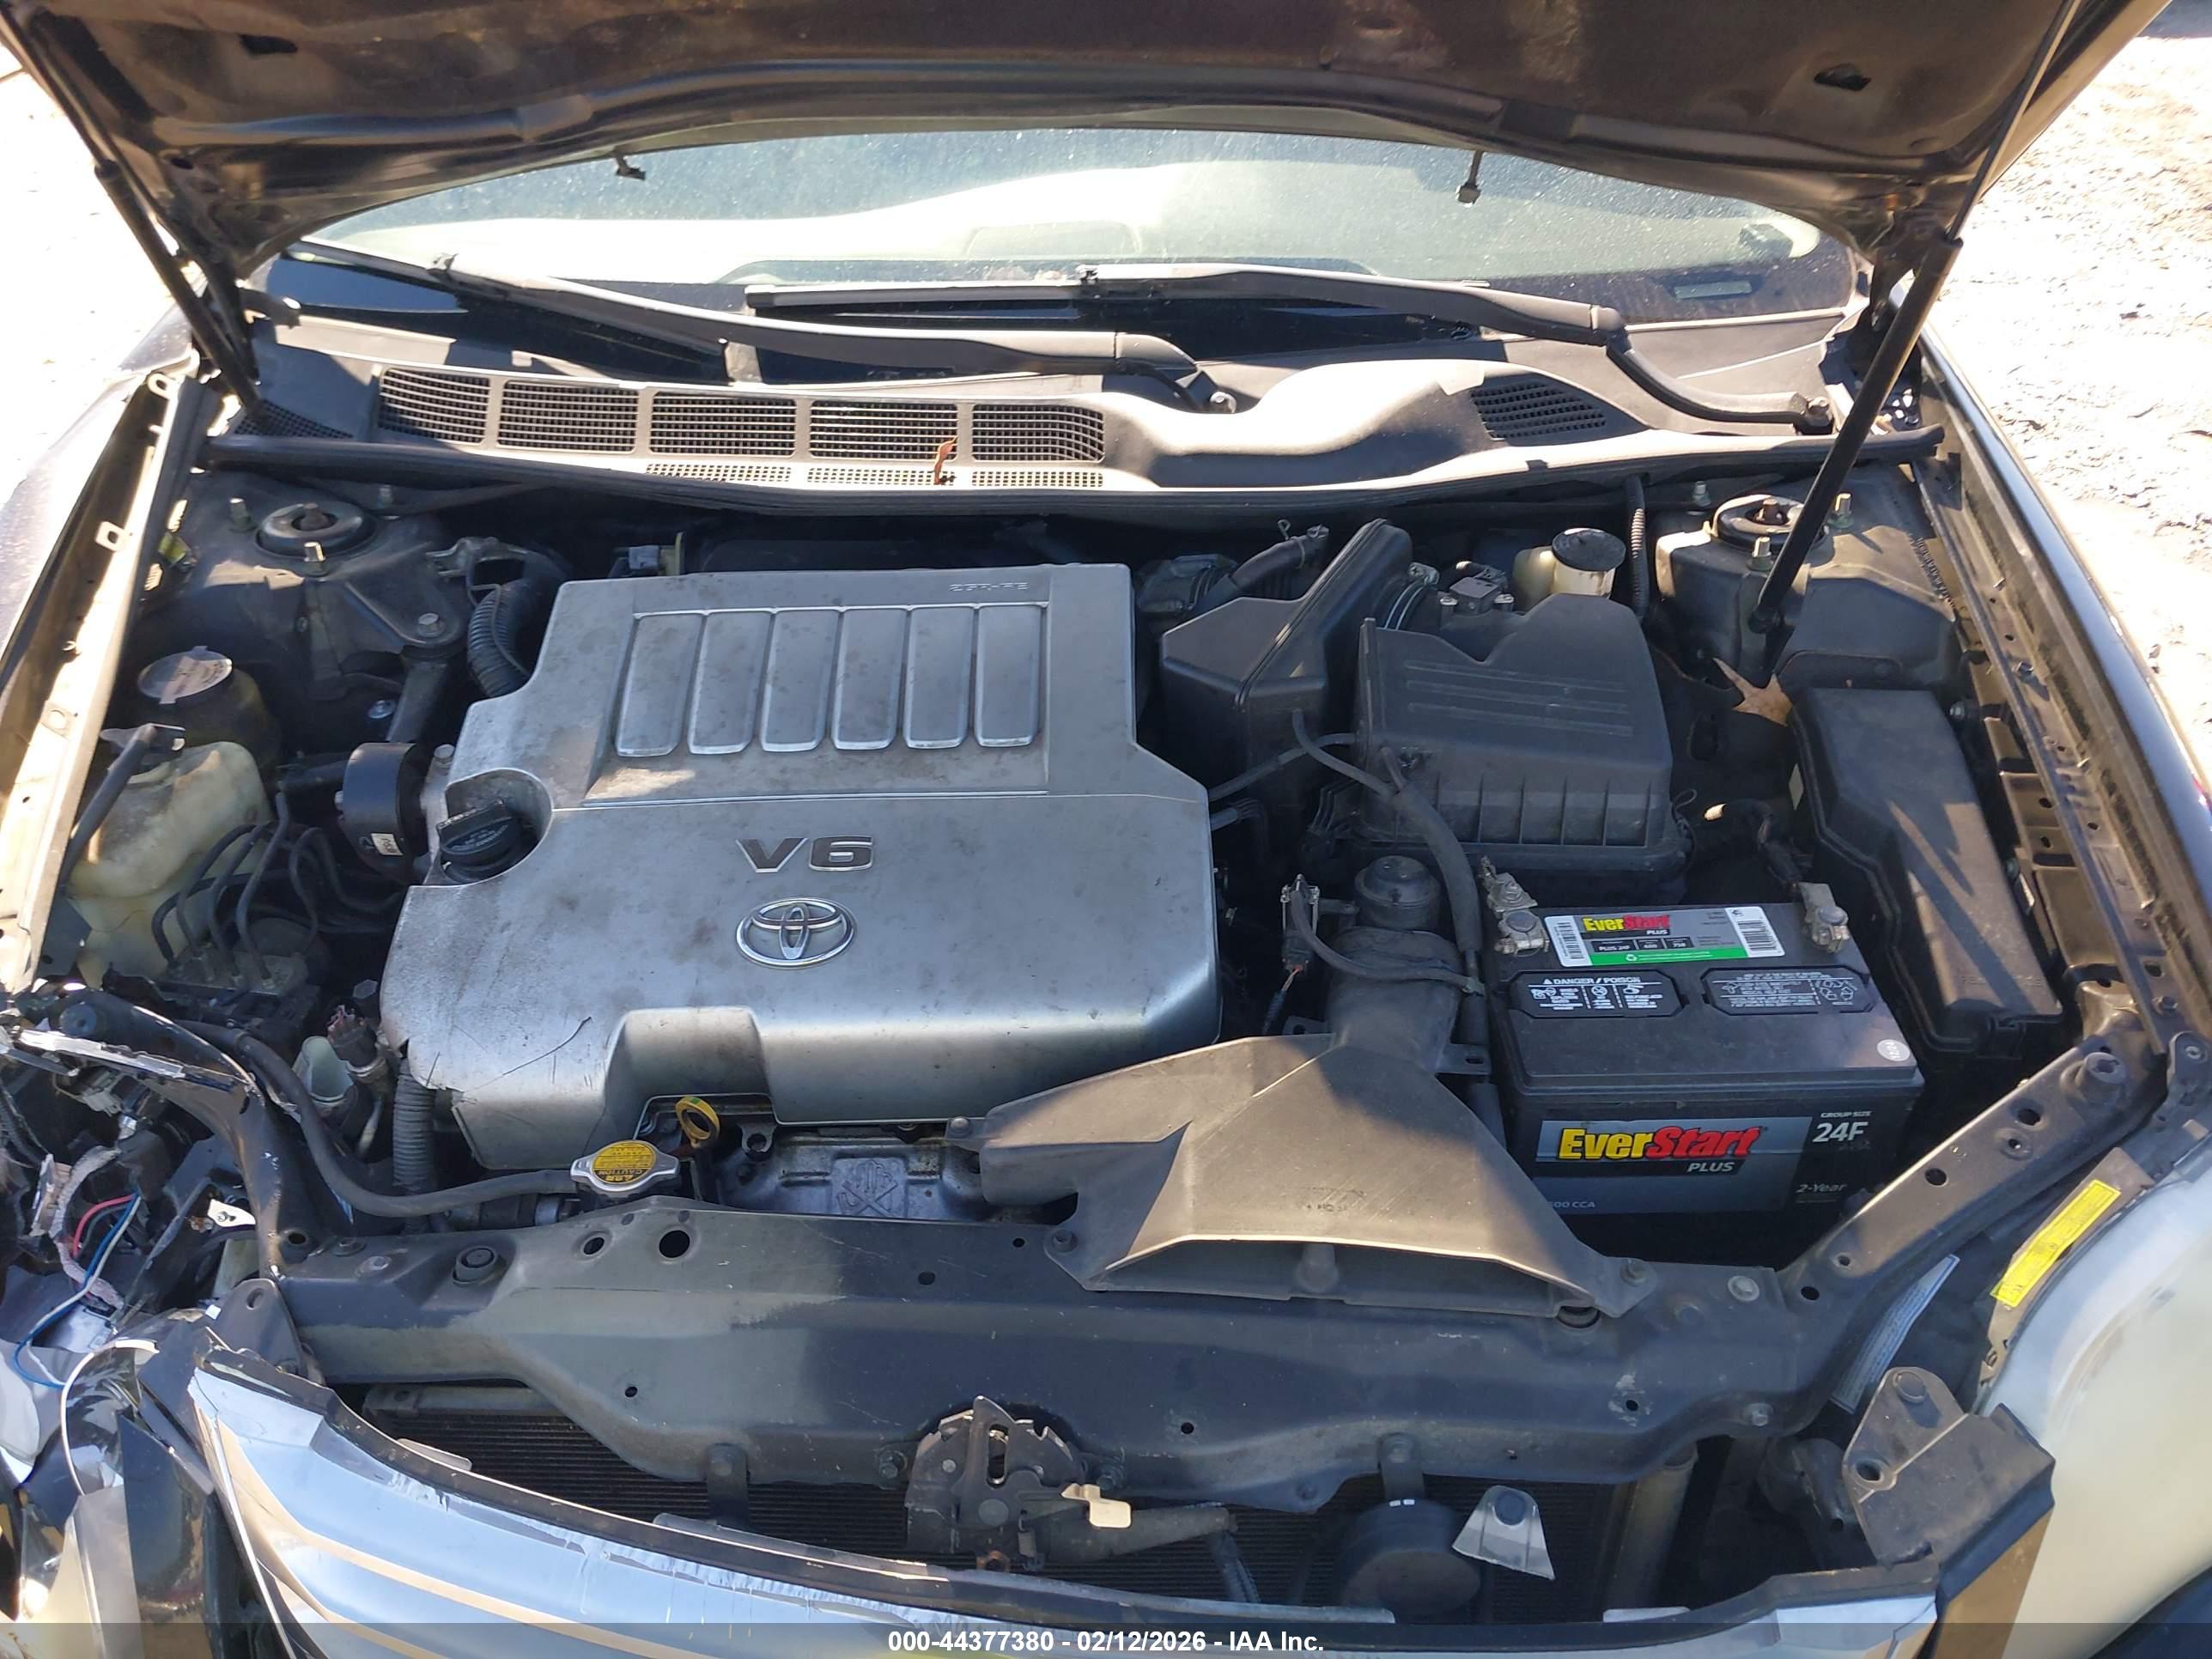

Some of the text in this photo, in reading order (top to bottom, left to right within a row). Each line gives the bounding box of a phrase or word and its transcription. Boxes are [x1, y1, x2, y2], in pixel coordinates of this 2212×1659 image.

[735, 836, 873, 873] V6
[1582, 914, 1670, 932] EverStart
[1812, 1121, 1869, 1143] 24F
[1558, 1126, 1762, 1160] EverStart
[1686, 1162, 1736, 1173] PLUS
[1796, 1183, 1848, 1194] 2-Year
